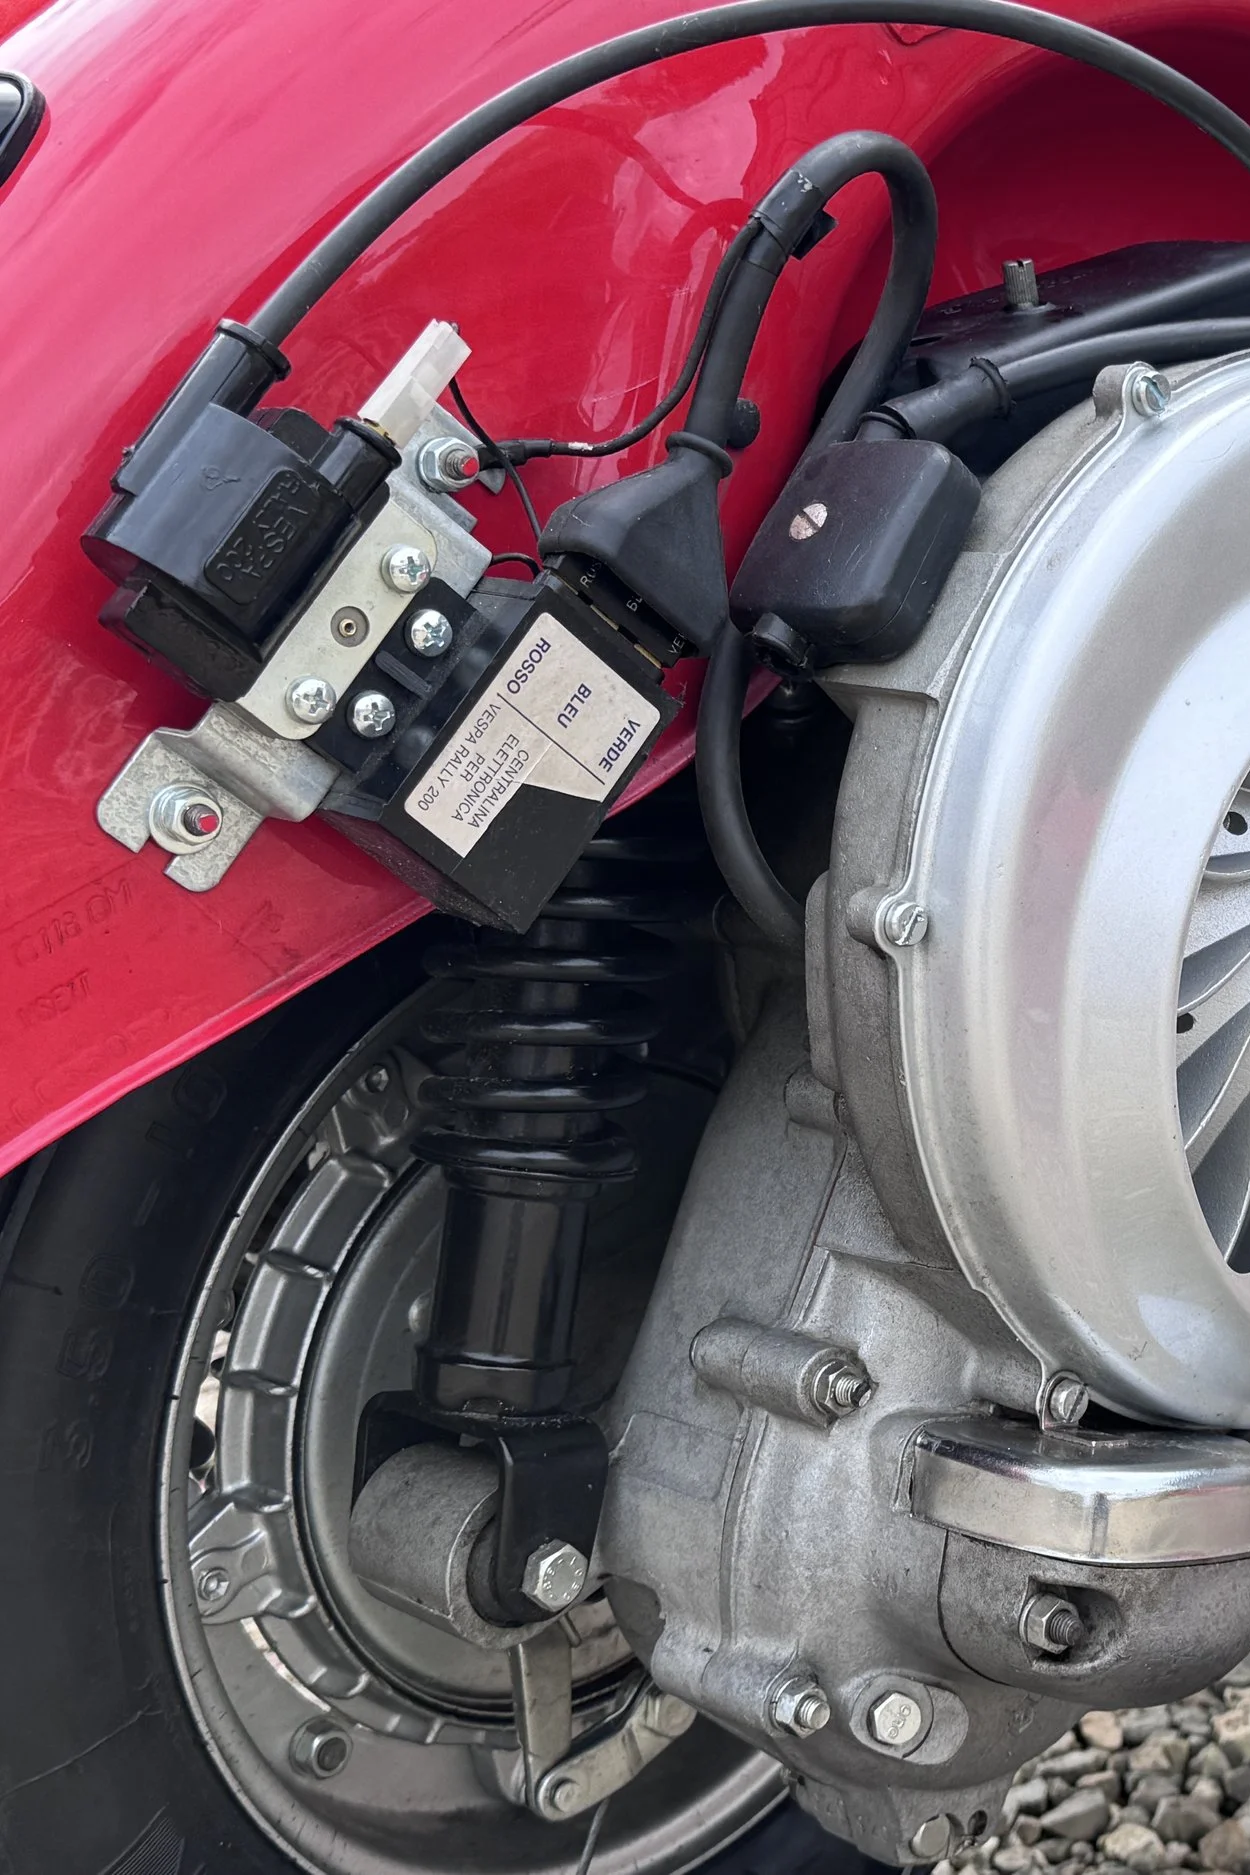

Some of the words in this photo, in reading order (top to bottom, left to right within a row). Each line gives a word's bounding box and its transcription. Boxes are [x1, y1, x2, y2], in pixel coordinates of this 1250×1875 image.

[507, 637, 552, 694] ROSSO
[465, 702, 502, 744] VESPA
[557, 683, 592, 729] BLEU
[440, 745, 470, 789] RALLY
[460, 752, 486, 782] PER
[598, 719, 641, 773] VERDE
[418, 782, 439, 812] 200
[451, 733, 520, 822] ELETTRONICA
[468, 749, 530, 829] CENTRALINA
